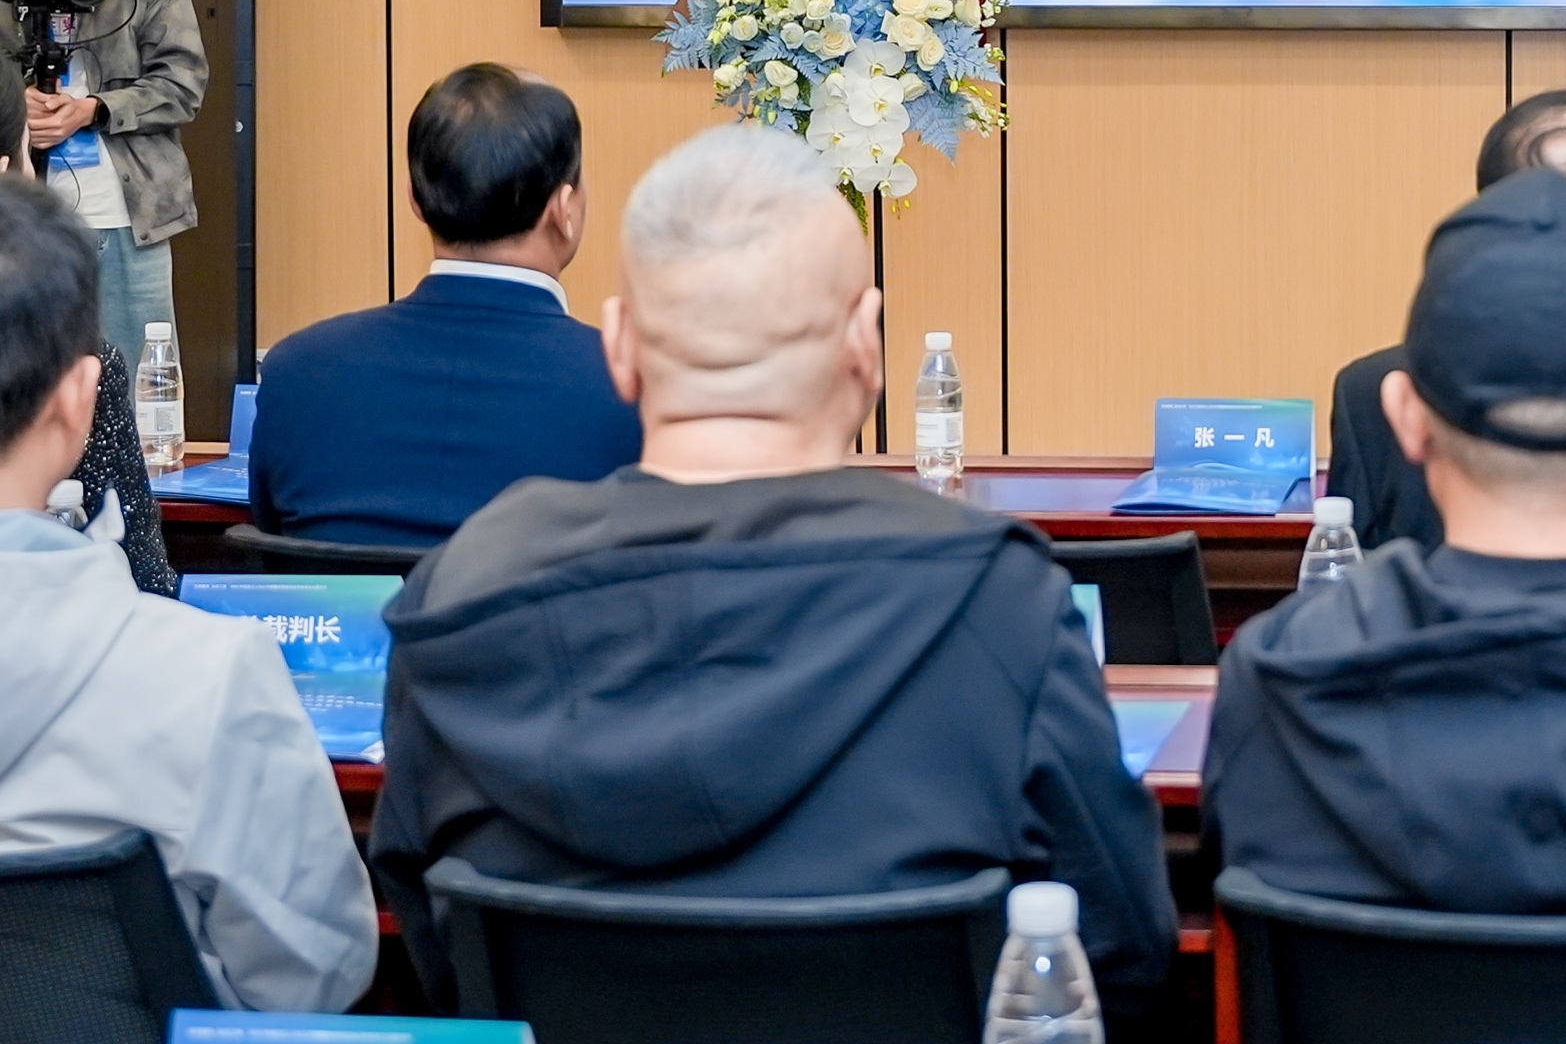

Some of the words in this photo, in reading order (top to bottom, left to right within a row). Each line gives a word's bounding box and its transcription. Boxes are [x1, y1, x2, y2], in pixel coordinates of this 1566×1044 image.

[1194, 427, 1275, 448] 张一凡
[251, 615, 341, 643] 裁判长
